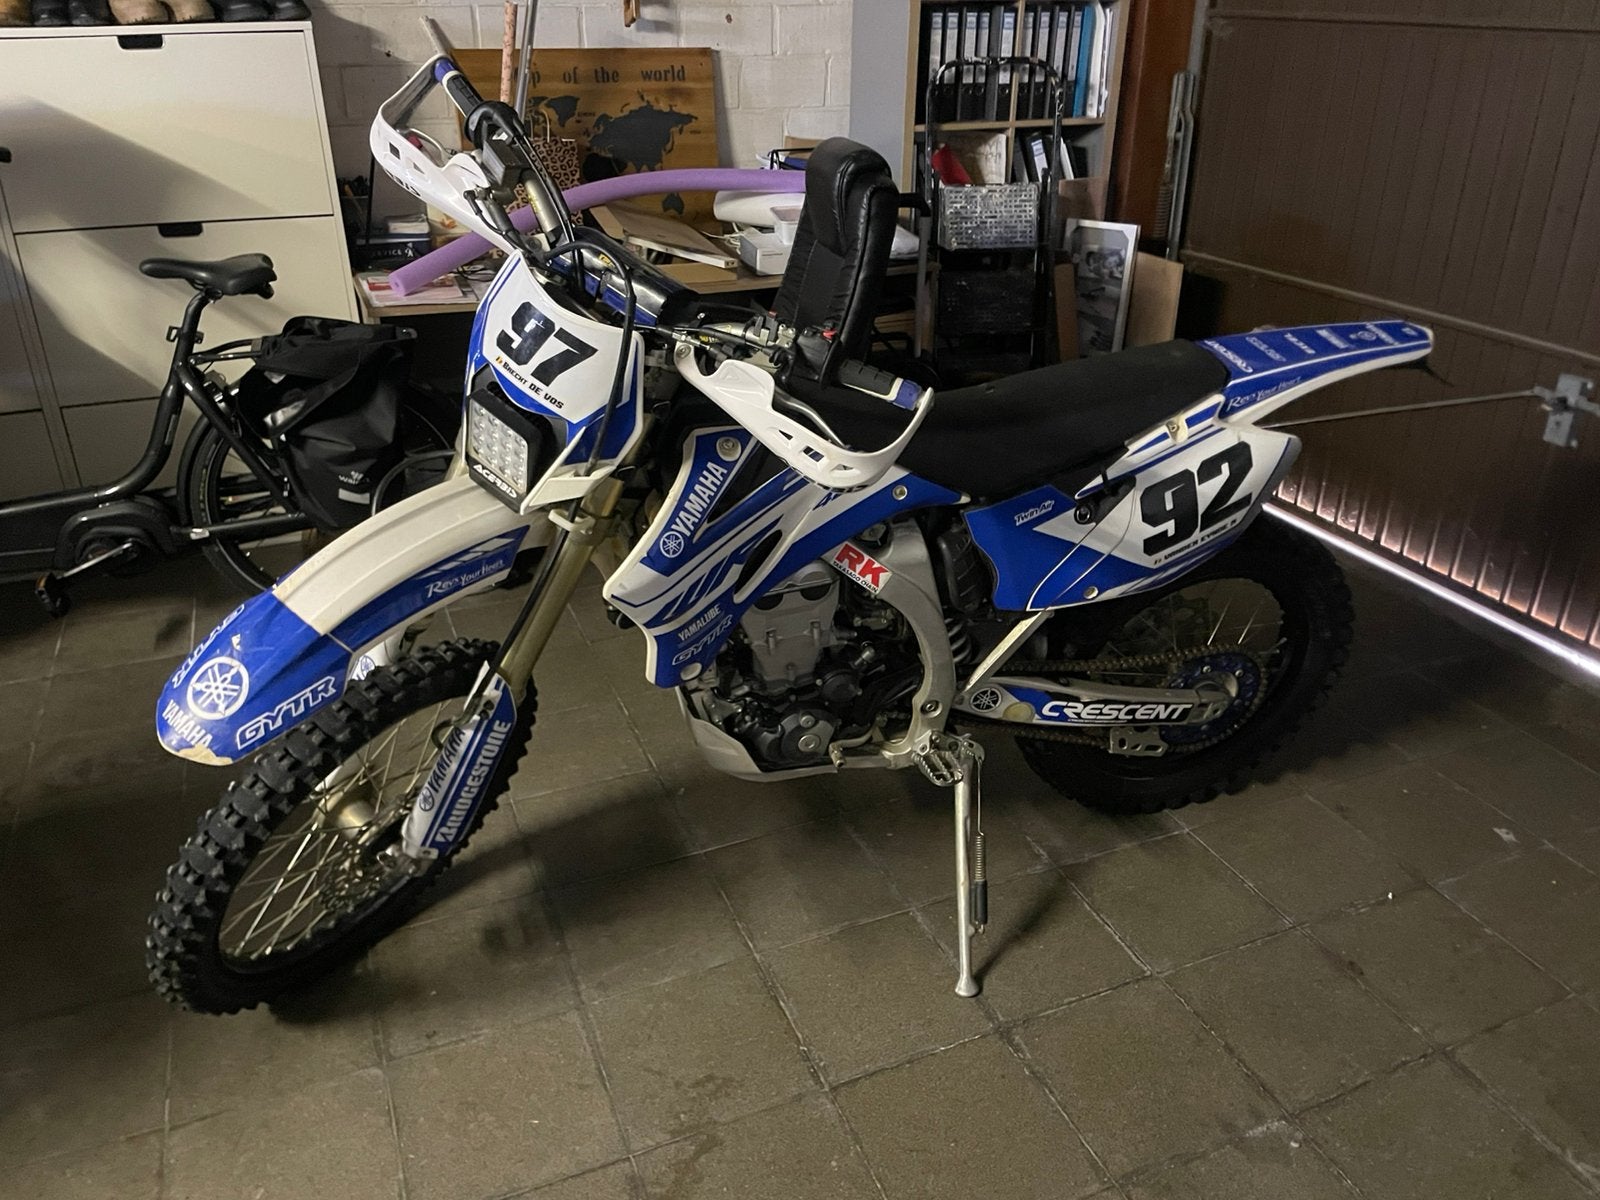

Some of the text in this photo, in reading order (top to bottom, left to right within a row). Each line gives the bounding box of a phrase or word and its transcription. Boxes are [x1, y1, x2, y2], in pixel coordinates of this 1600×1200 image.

[562, 65, 686, 84] of the world
[496, 301, 599, 387] 97
[502, 361, 529, 386] BRECHT
[528, 382, 543, 396] DE
[473, 464, 518, 498] ACERBIS
[671, 461, 728, 537] YAMAHA
[1140, 440, 1253, 556] 92
[835, 543, 889, 588] RK
[861, 580, 879, 593] CHAIN
[678, 603, 721, 641] YAMALUBE
[162, 699, 213, 748] YAMAHA
[236, 676, 337, 751] GYTR
[1041, 700, 1194, 720] CRESCENT
[427, 727, 466, 794] YAMAHA
[435, 720, 512, 843] BRIDGESTONE
